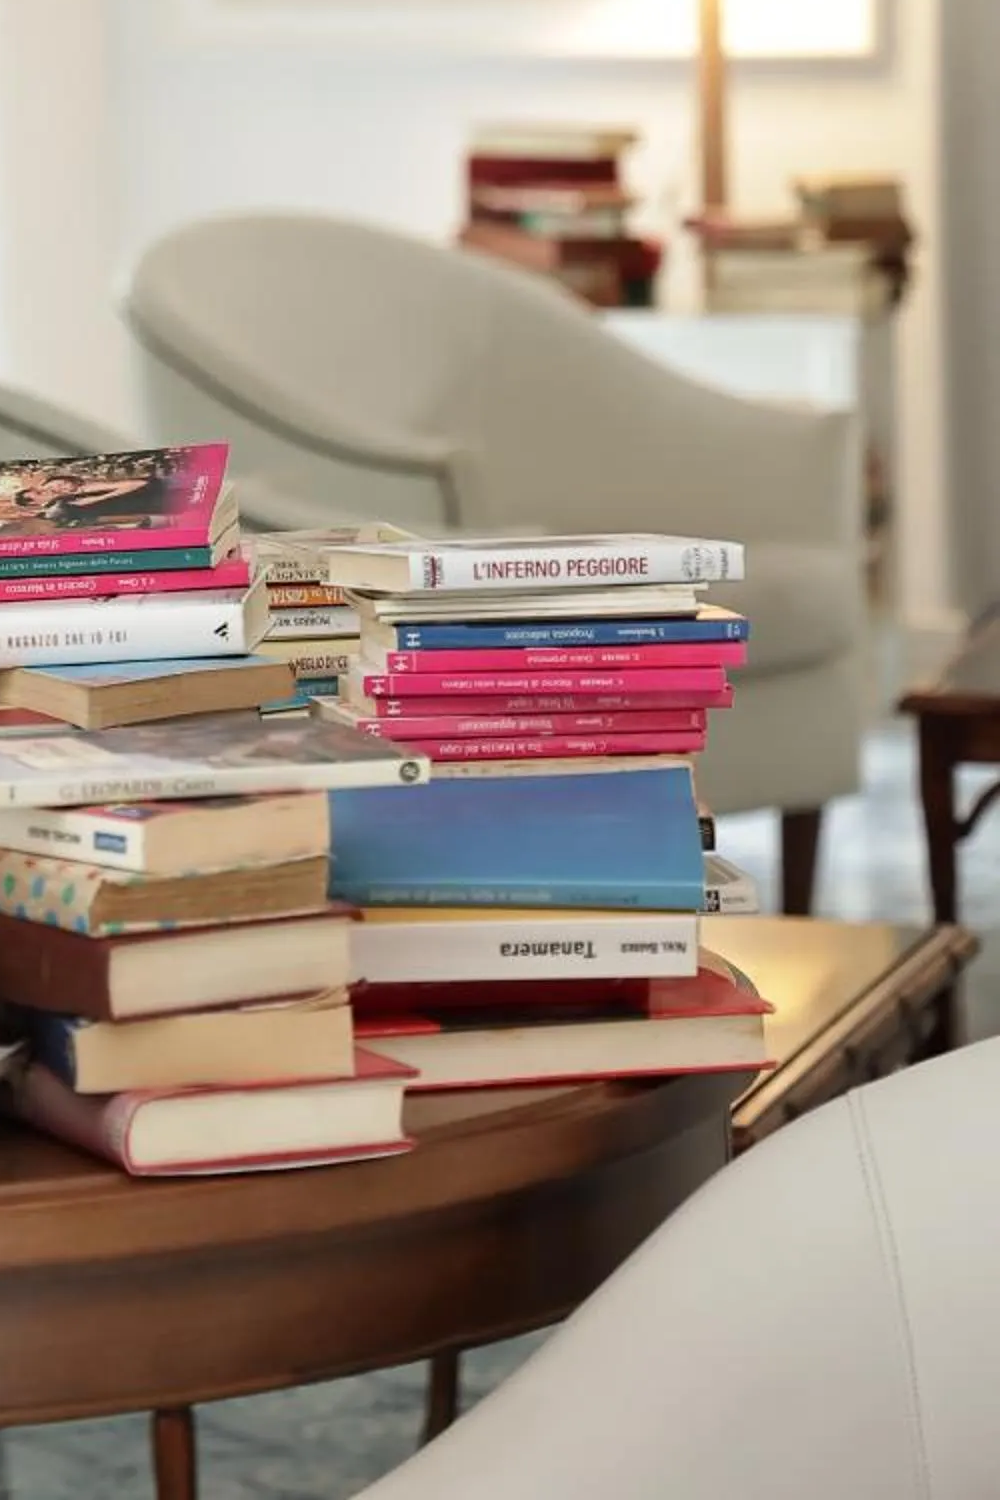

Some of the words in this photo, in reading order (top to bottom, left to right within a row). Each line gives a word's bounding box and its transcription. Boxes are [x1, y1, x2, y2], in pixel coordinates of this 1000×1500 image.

[472, 559, 561, 581] L'INFERNO
[566, 556, 649, 578] PEGGIORE
[5, 583, 44, 595] Marocco
[57, 580, 97, 591] Crociera
[552, 627, 594, 640] Proposta
[7, 633, 60, 649] RAGAZZO
[499, 940, 598, 959] Tanamera
